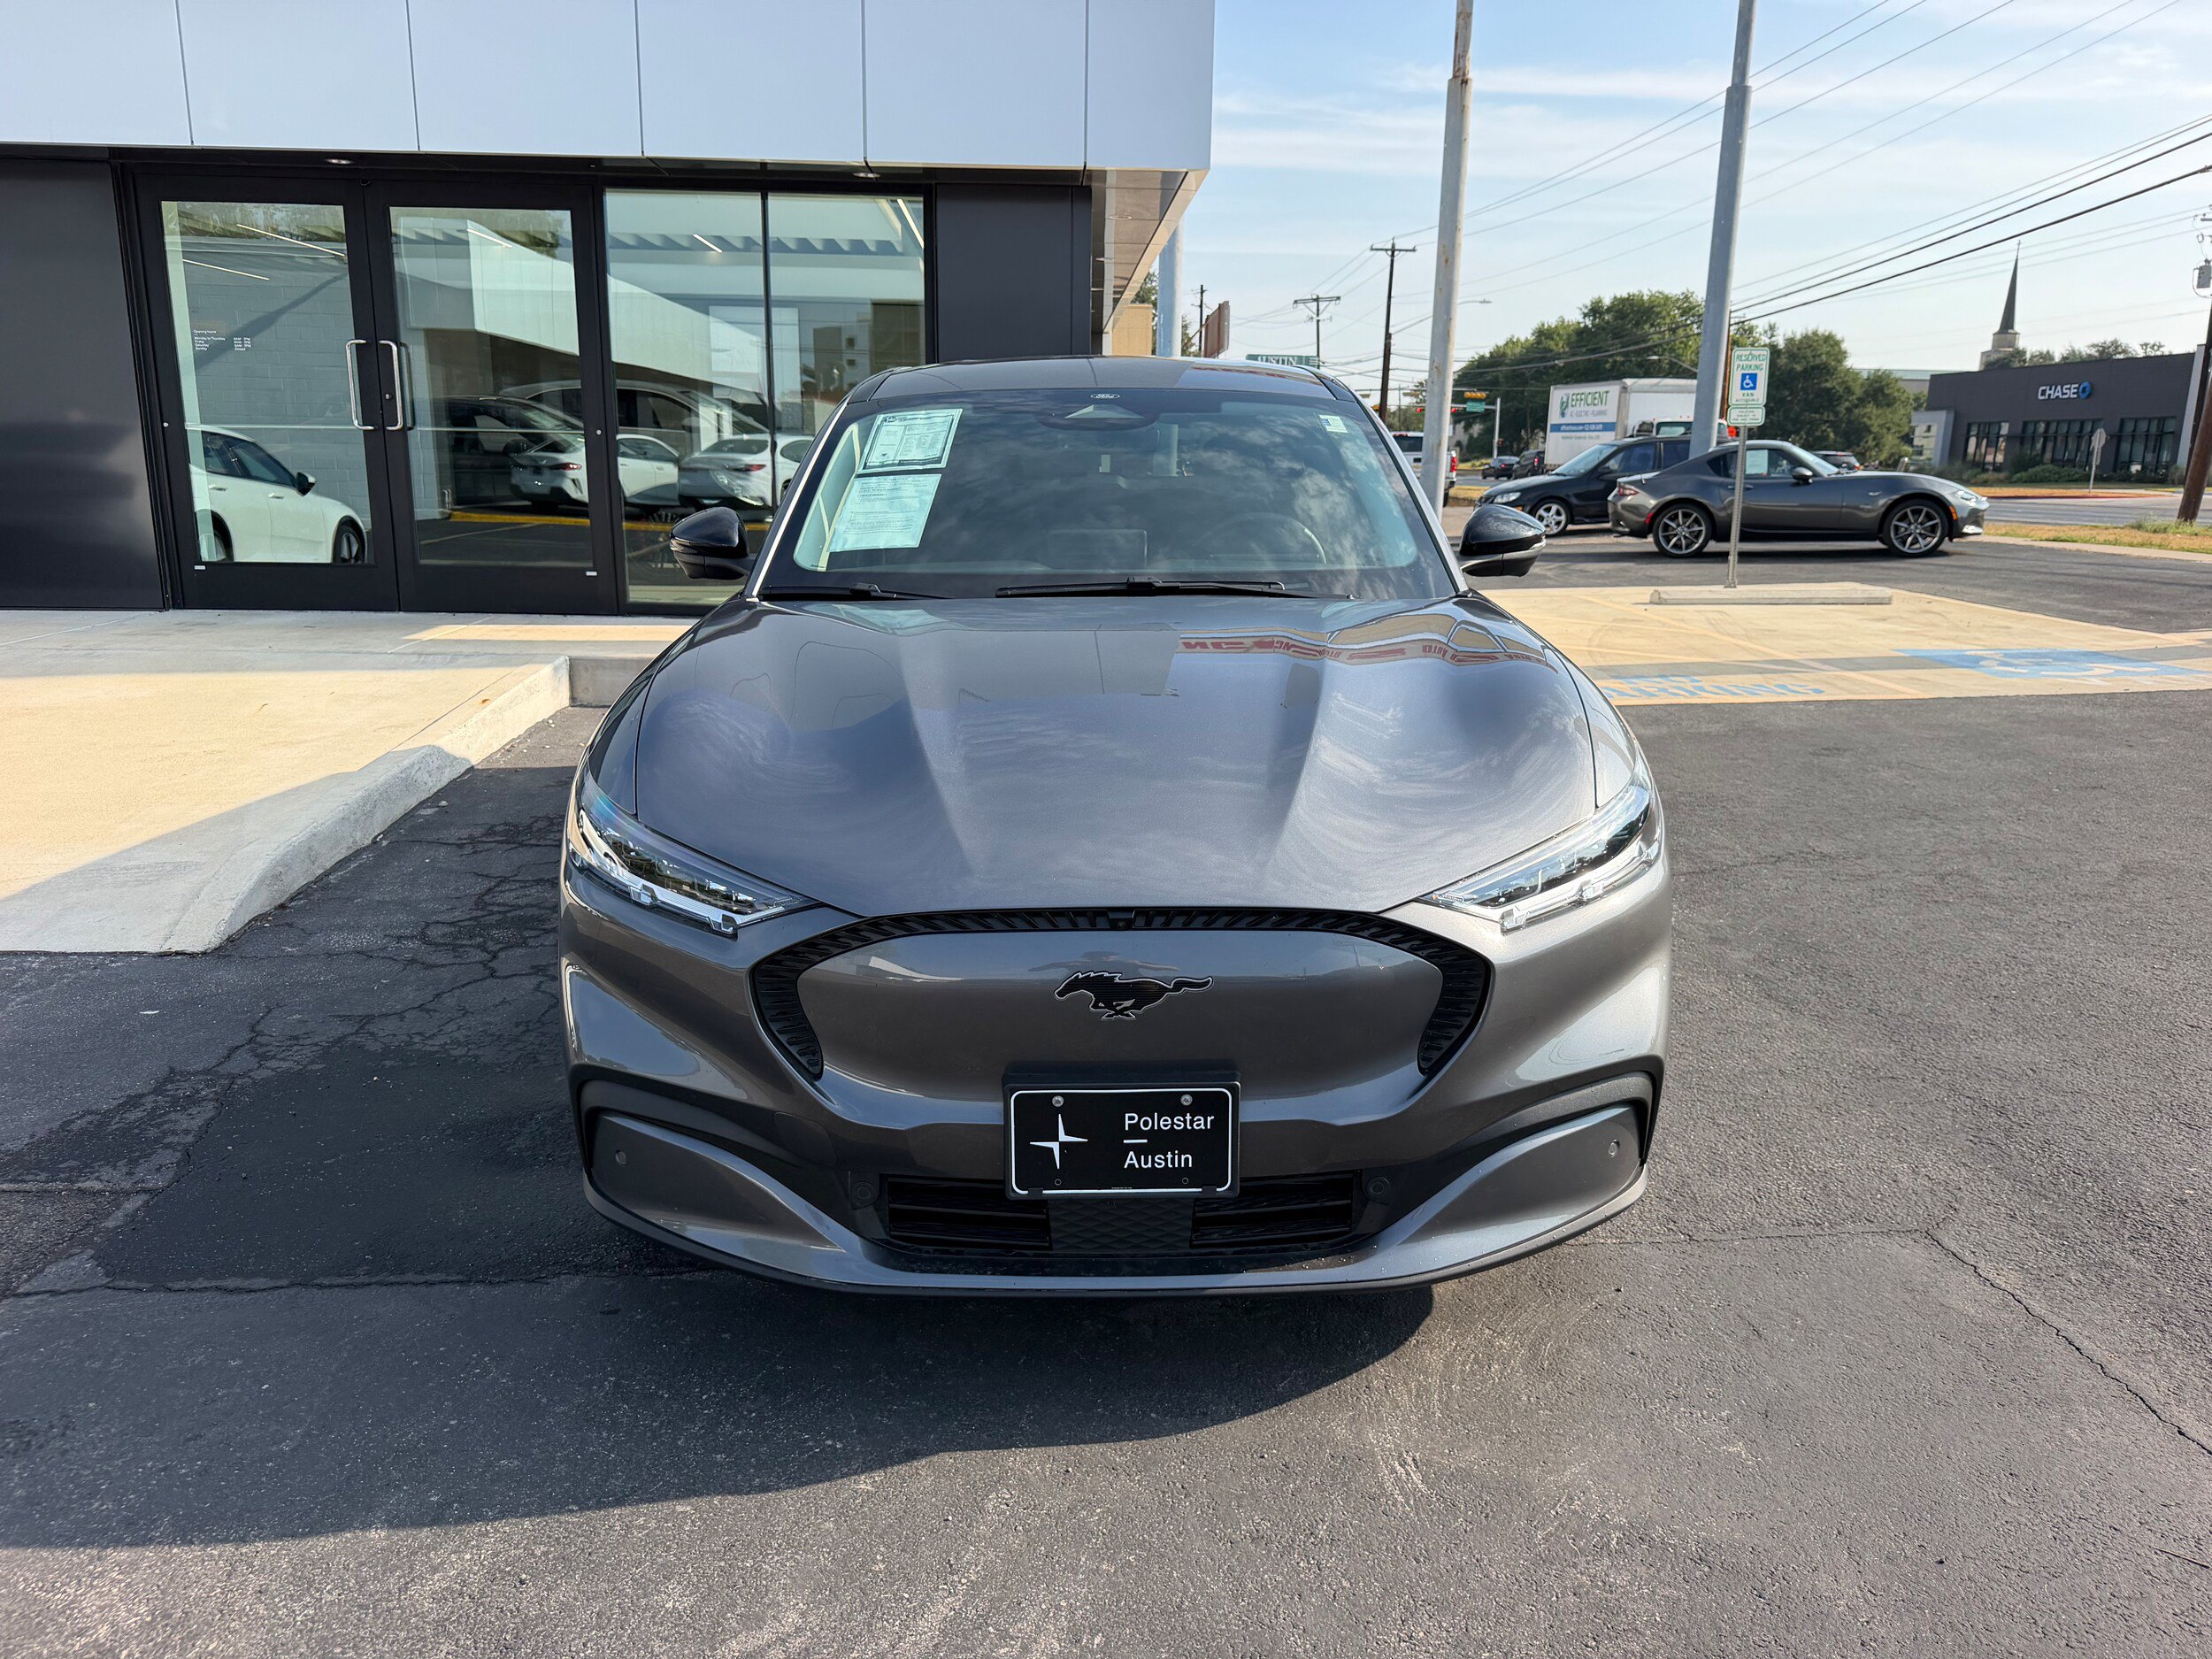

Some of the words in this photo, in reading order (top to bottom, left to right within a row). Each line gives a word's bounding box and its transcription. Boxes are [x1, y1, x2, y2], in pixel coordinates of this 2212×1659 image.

[1256, 356, 1298, 365] AUSTIN
[1571, 390, 1610, 408] EFFICIENT
[2038, 383, 2079, 400] CHASE
[1601, 683, 1824, 698] ARKING
[1124, 1111, 1216, 1131] Polestar
[1123, 1149, 1194, 1169] Austin
